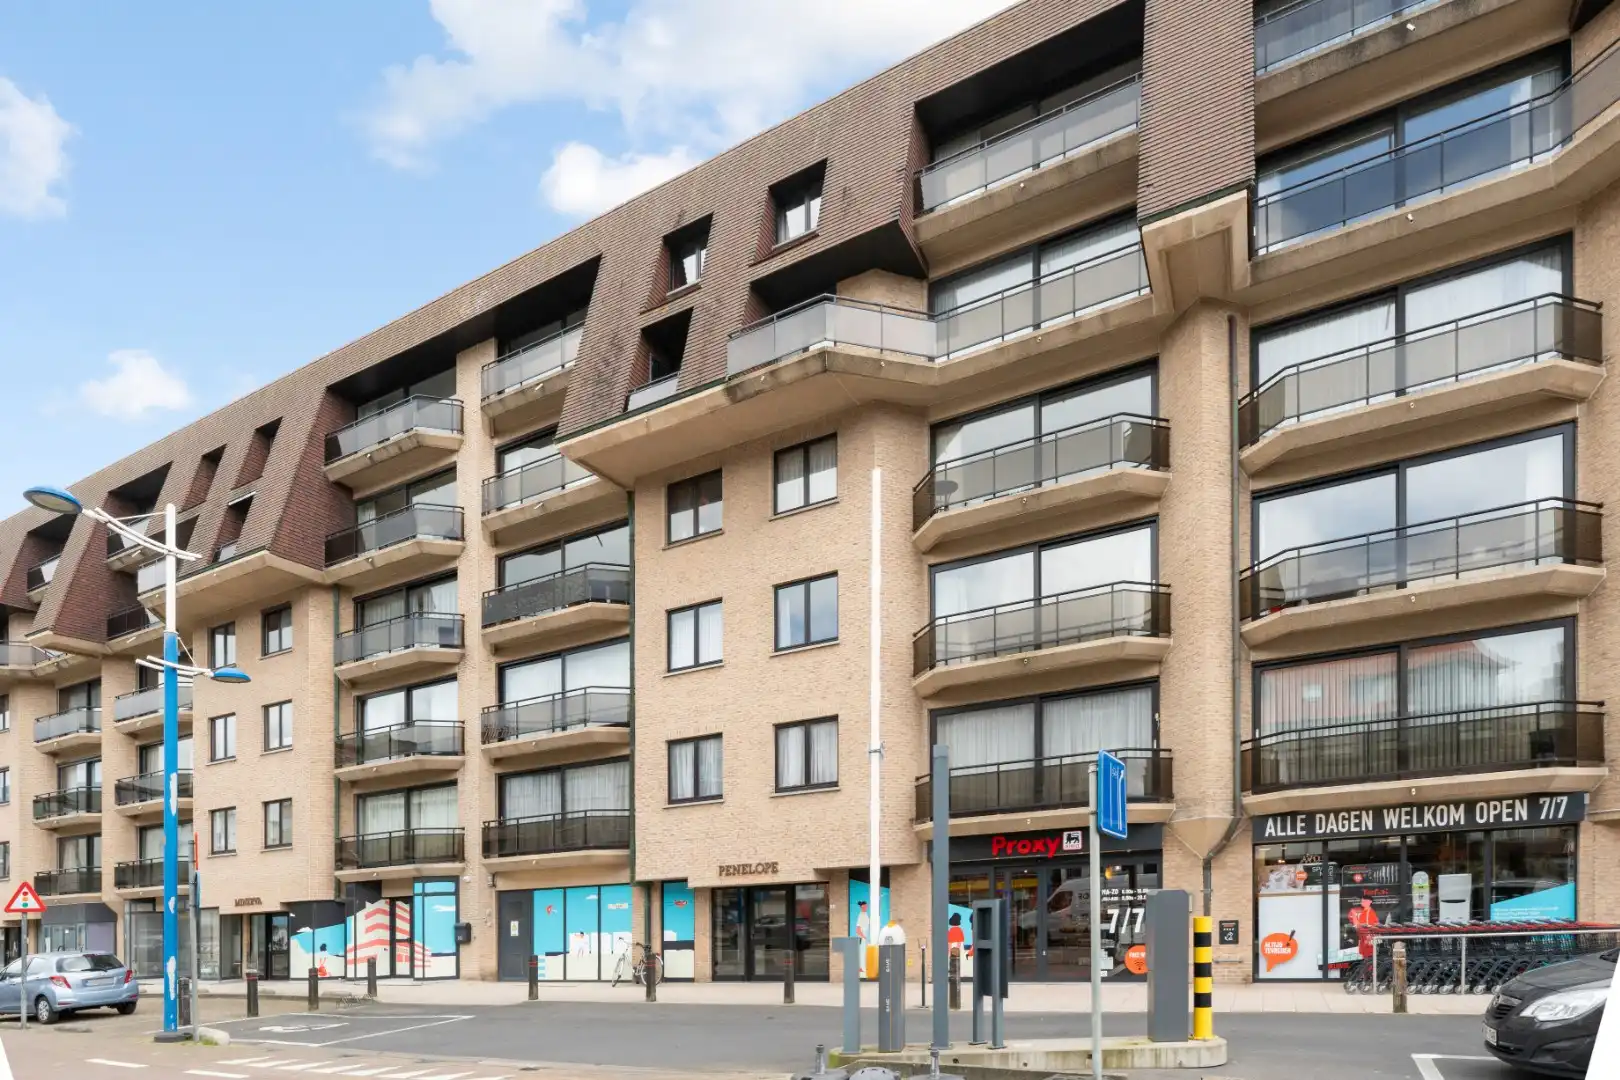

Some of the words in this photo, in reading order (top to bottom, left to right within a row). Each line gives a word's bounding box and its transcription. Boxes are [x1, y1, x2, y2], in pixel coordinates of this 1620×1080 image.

[1264, 814, 1307, 837] ALLE
[1315, 809, 1374, 834] DAGEN
[1383, 803, 1465, 829] WELKOM
[1475, 798, 1528, 824] OPEN
[1539, 796, 1569, 820] 7/7
[991, 836, 1061, 858] Proxy
[718, 861, 779, 877] PENELOPE
[1107, 907, 1145, 934] 7/7
